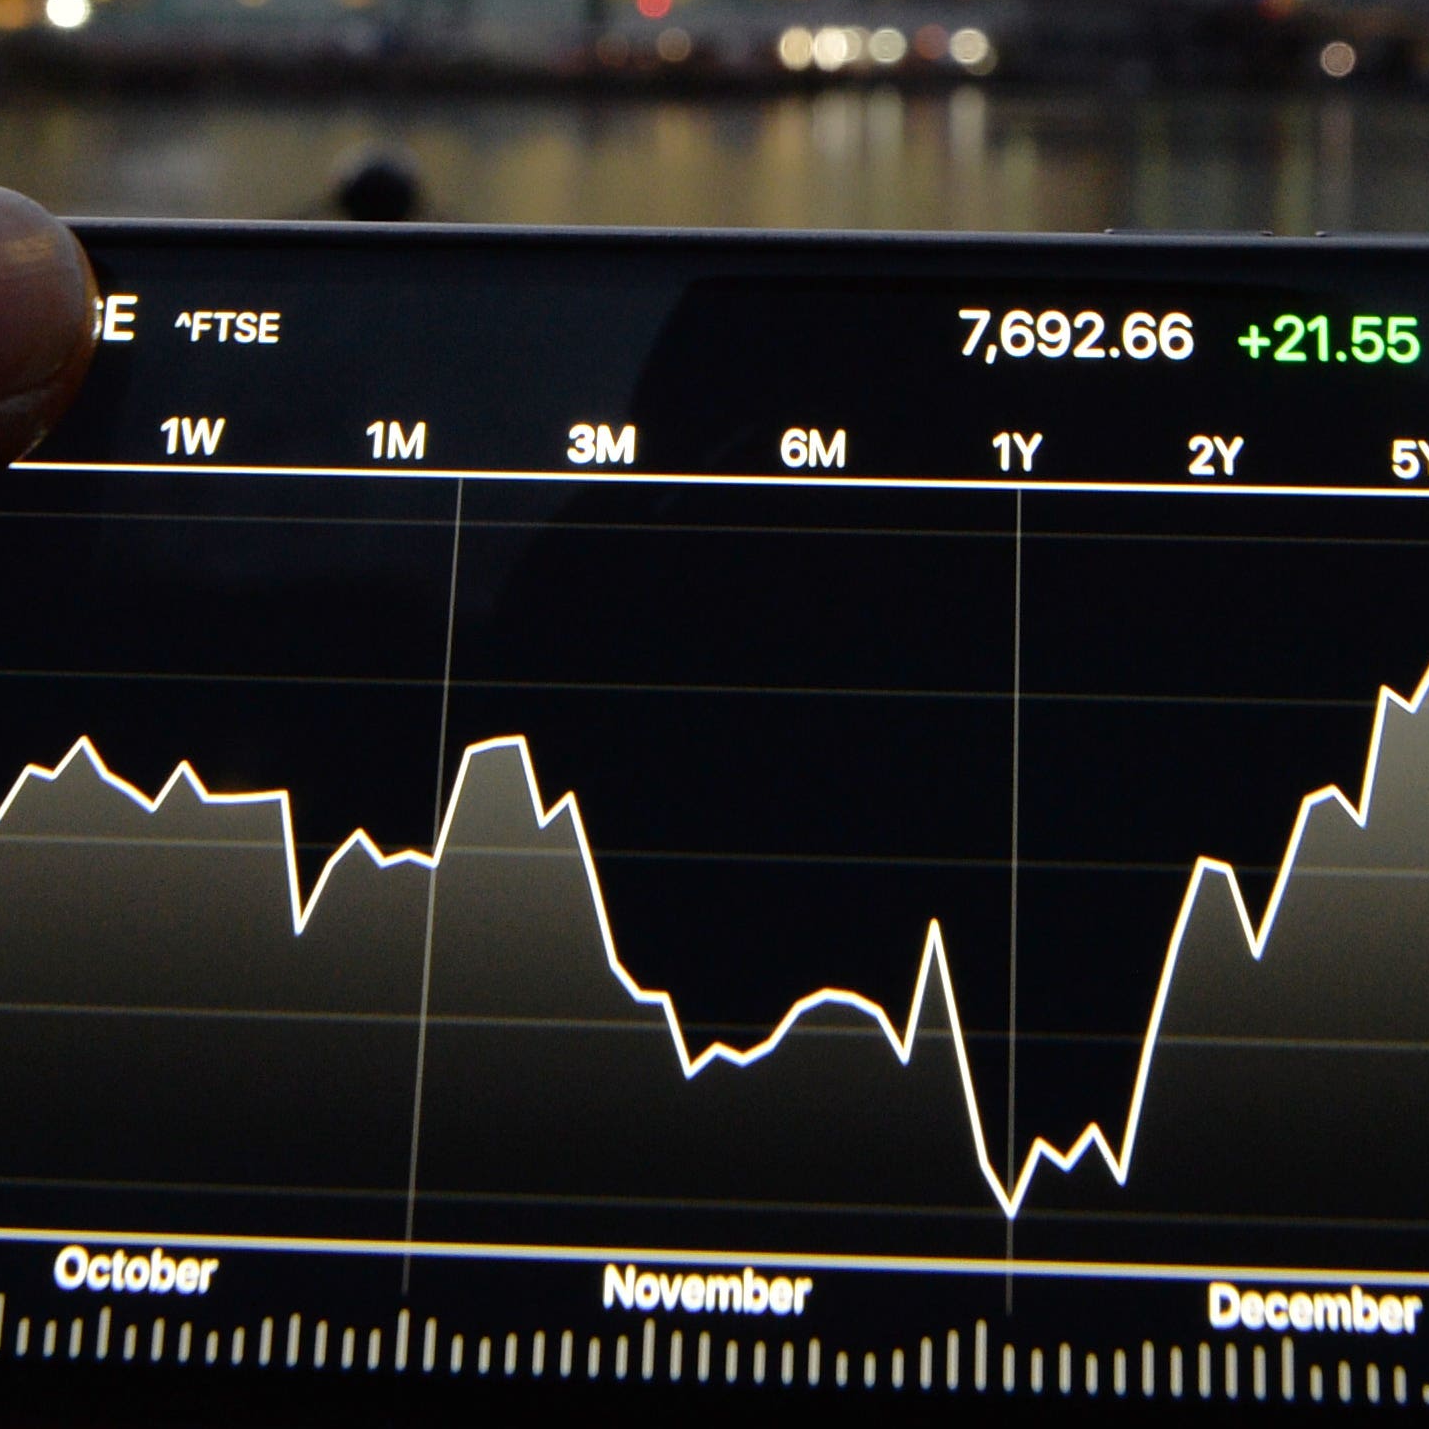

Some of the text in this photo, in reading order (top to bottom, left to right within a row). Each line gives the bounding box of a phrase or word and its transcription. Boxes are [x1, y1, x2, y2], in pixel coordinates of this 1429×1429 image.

[174, 310, 282, 345] ^FTSE
[958, 307, 1195, 366] 7,692.66
[1237, 313, 1422, 366] +21.55
[159, 415, 227, 458] 1W
[365, 420, 427, 461] 1M
[566, 422, 637, 466] 3M
[780, 426, 847, 469] 6M
[992, 431, 1043, 473] 1Y
[1188, 435, 1245, 478] 2Y
[53, 1243, 1424, 1334] October November December
